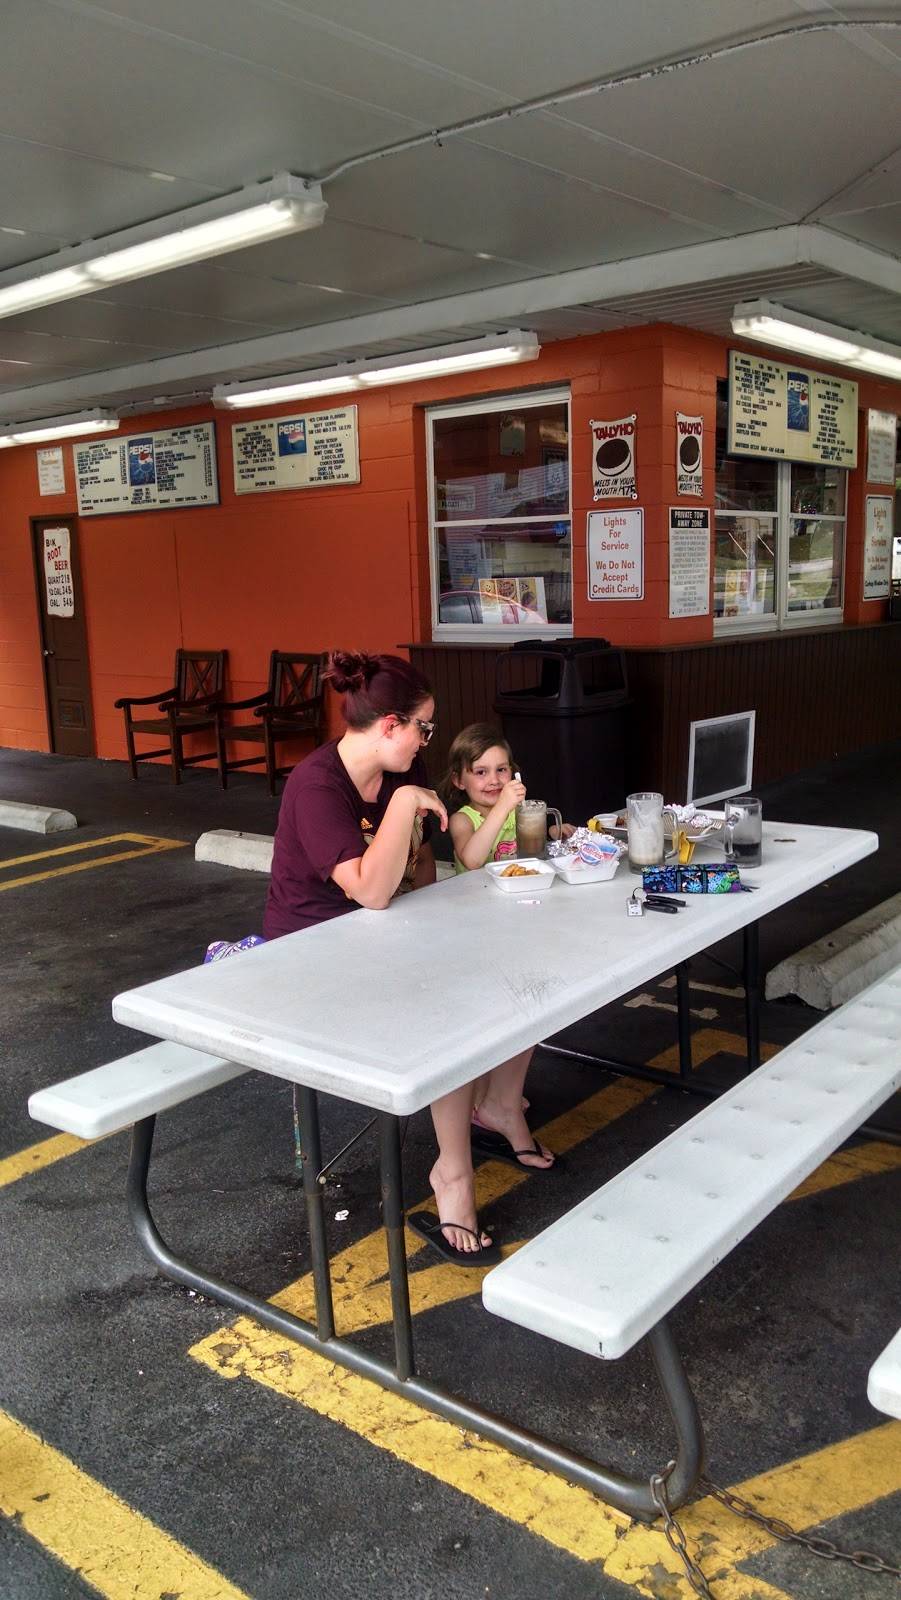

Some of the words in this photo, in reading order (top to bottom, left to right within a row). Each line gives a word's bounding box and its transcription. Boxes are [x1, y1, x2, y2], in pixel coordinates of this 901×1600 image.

[279, 422, 304, 434] PEPSI
[619, 477, 634, 485] YOUR
[604, 517, 626, 528] Lights
[609, 529, 621, 538] For
[601, 541, 629, 550] Service
[47, 546, 61, 562] ROOT
[54, 560, 68, 570] BEER
[596, 561, 606, 570] We
[609, 561, 619, 569] Do
[622, 560, 635, 568] Not
[602, 573, 628, 583] Accept
[592, 585, 615, 593] Credit
[617, 584, 639, 593] Cards
